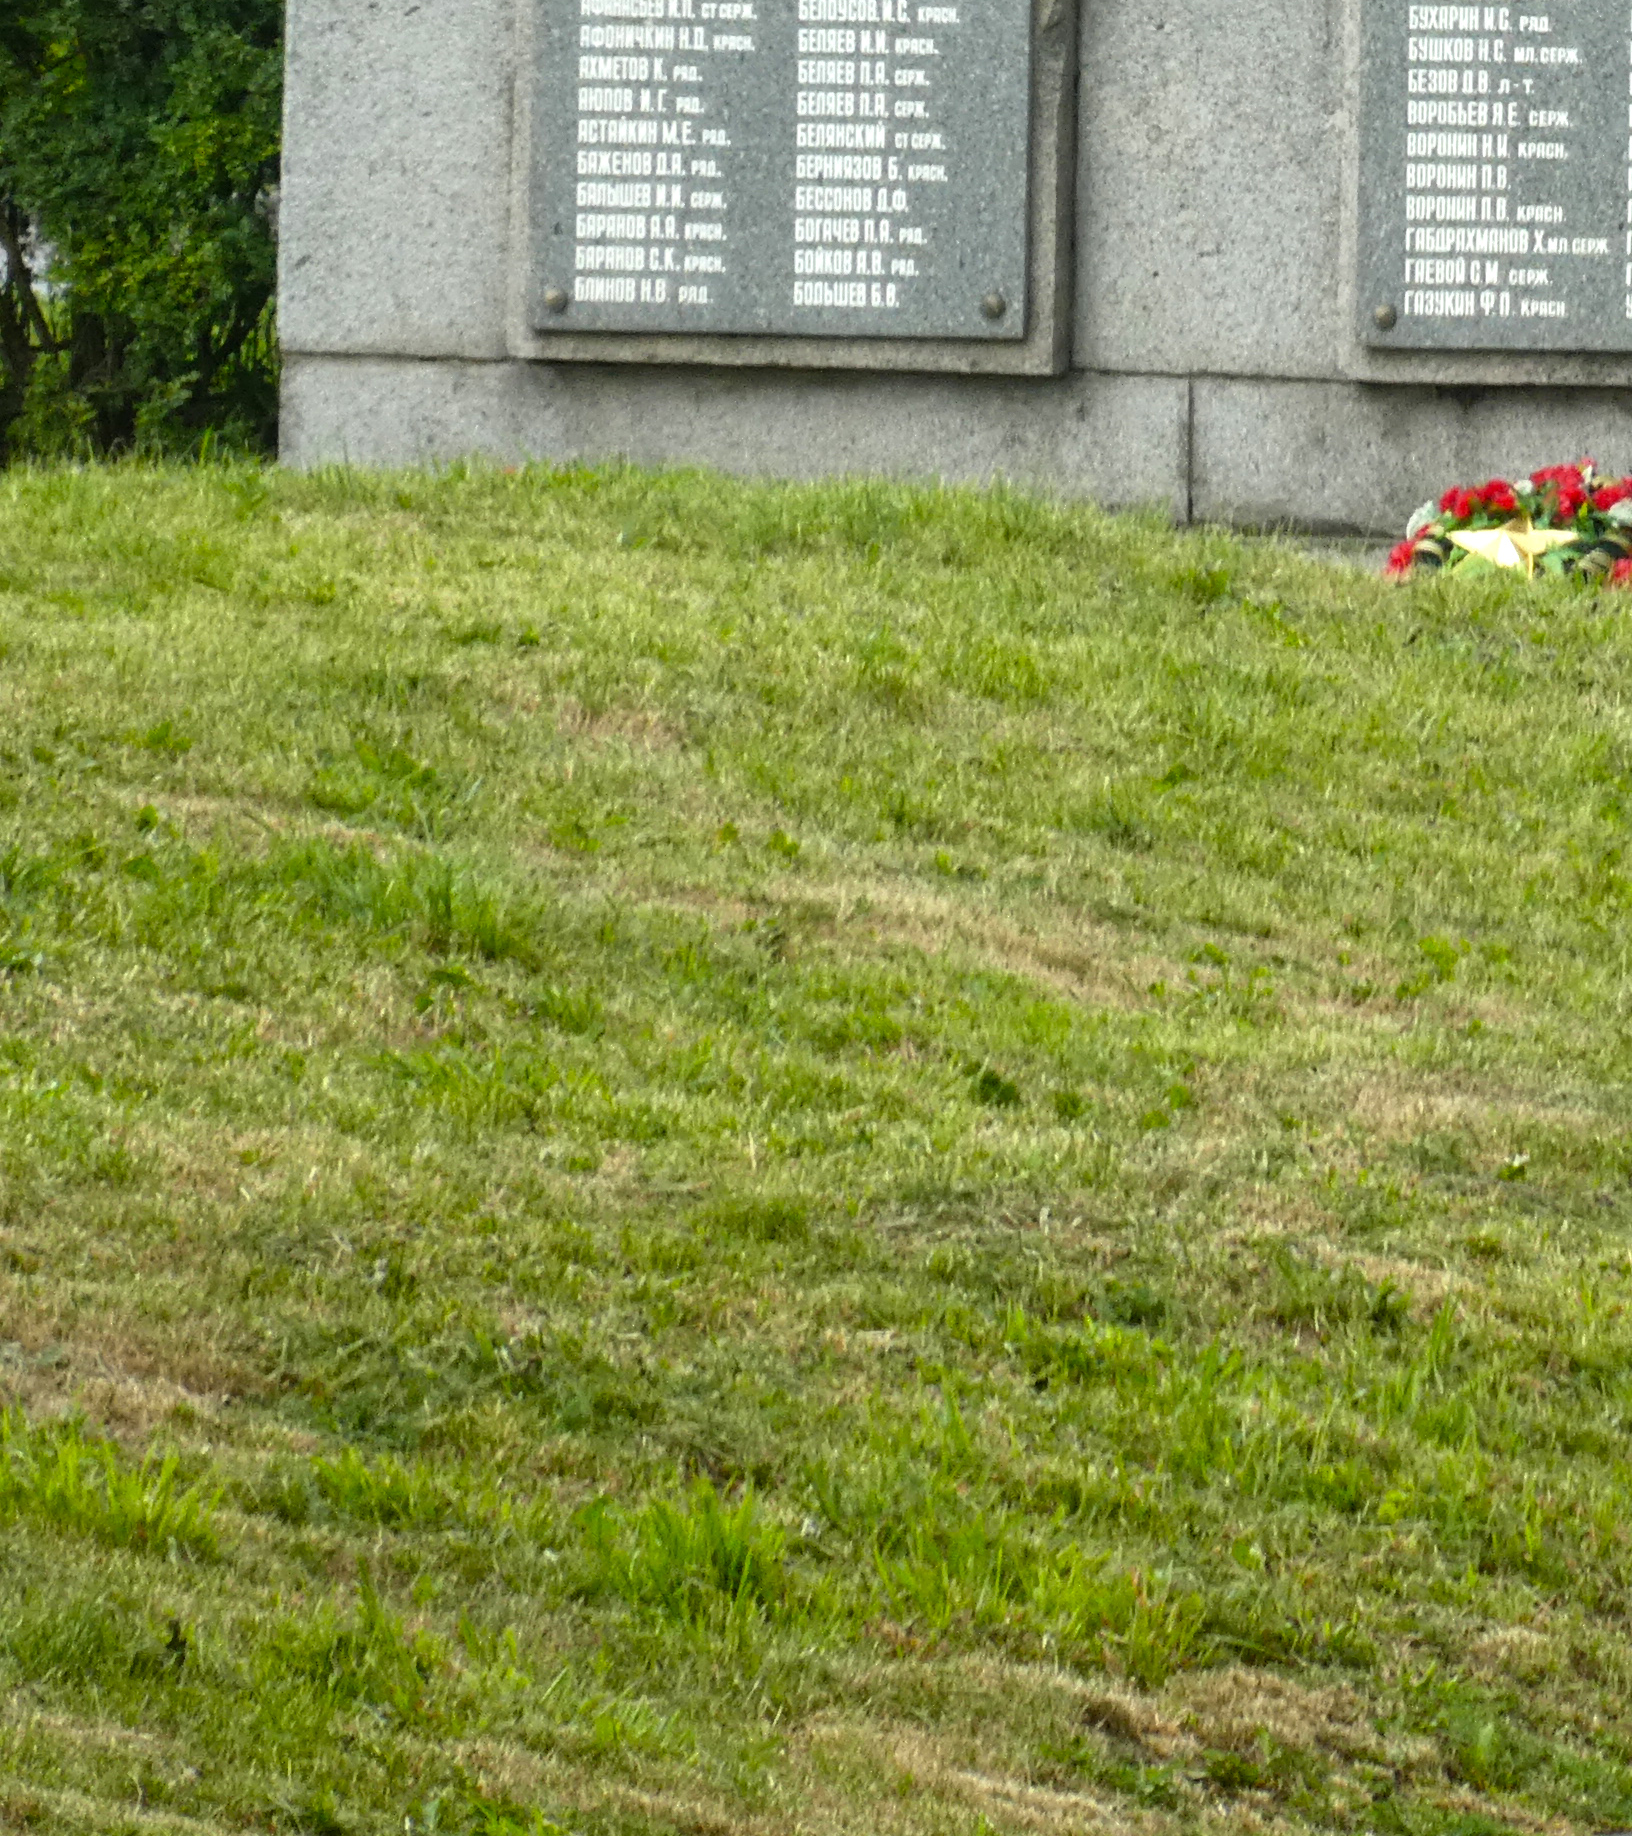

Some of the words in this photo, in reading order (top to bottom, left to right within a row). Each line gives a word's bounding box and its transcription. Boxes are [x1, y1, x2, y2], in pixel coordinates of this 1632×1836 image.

[1408, 4, 1480, 31] БУХАРИН
[1407, 36, 1475, 63] БУШКОВ
[578, 55, 650, 81] АХМЕТОВ
[797, 59, 856, 84] БЕЛЯЕВ
[1407, 68, 1459, 94] БЕЗОВ
[577, 87, 634, 112] АЮПОВ
[1407, 99, 1489, 126] ВОРОБЬЕВ
[577, 115, 659, 144] АСТАЙКИН
[796, 119, 886, 149] БЕЛЯНСКИЙ
[1406, 131, 1478, 158] ВОРОНИН
[576, 150, 653, 176] БАЖЕНОВ
[794, 185, 873, 212] БЕССОНОВ
[575, 213, 647, 239] БАРАНОВ
[794, 217, 861, 242] БОГАЧЕВ
[793, 245, 853, 275] БОЙКОВ
[793, 281, 867, 308] БОЛЬШЕВ
